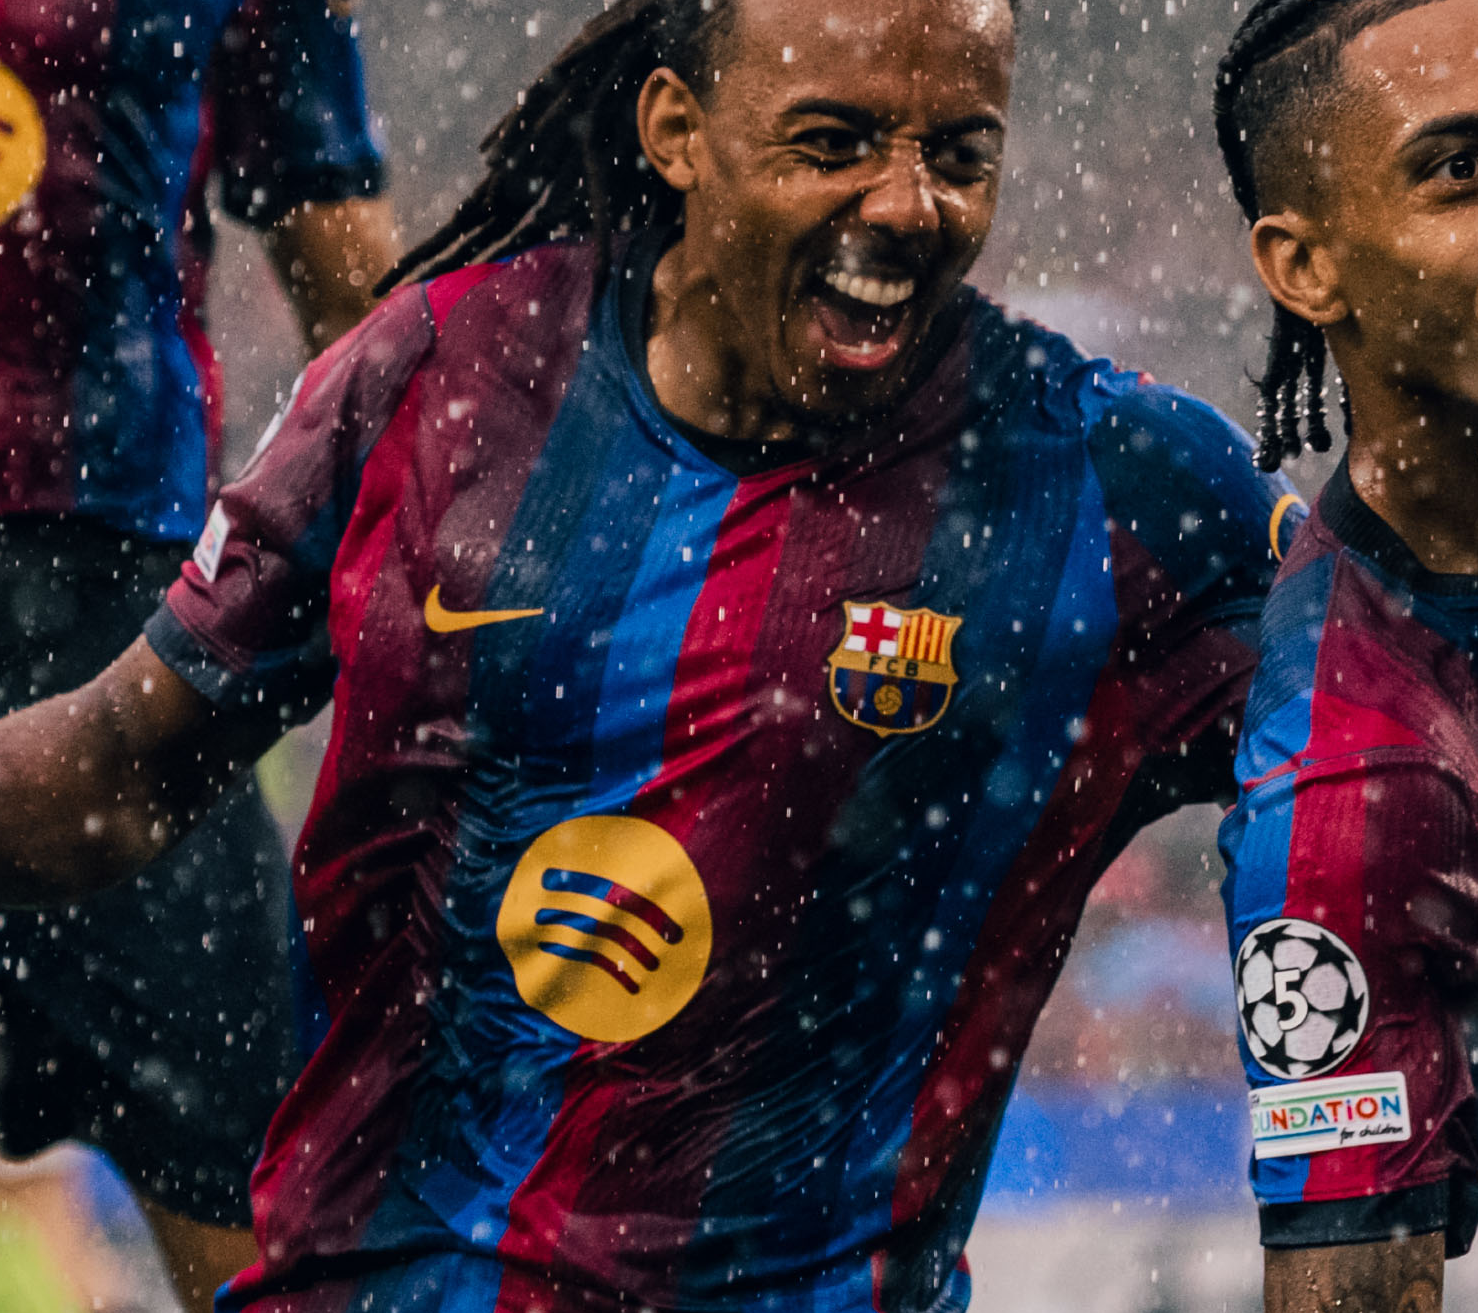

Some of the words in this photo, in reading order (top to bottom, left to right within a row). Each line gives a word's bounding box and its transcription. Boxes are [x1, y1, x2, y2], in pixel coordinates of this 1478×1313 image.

[1273, 967, 1309, 1031] 5
[1339, 1126, 1355, 1145] for
[1359, 1123, 1403, 1137] children
